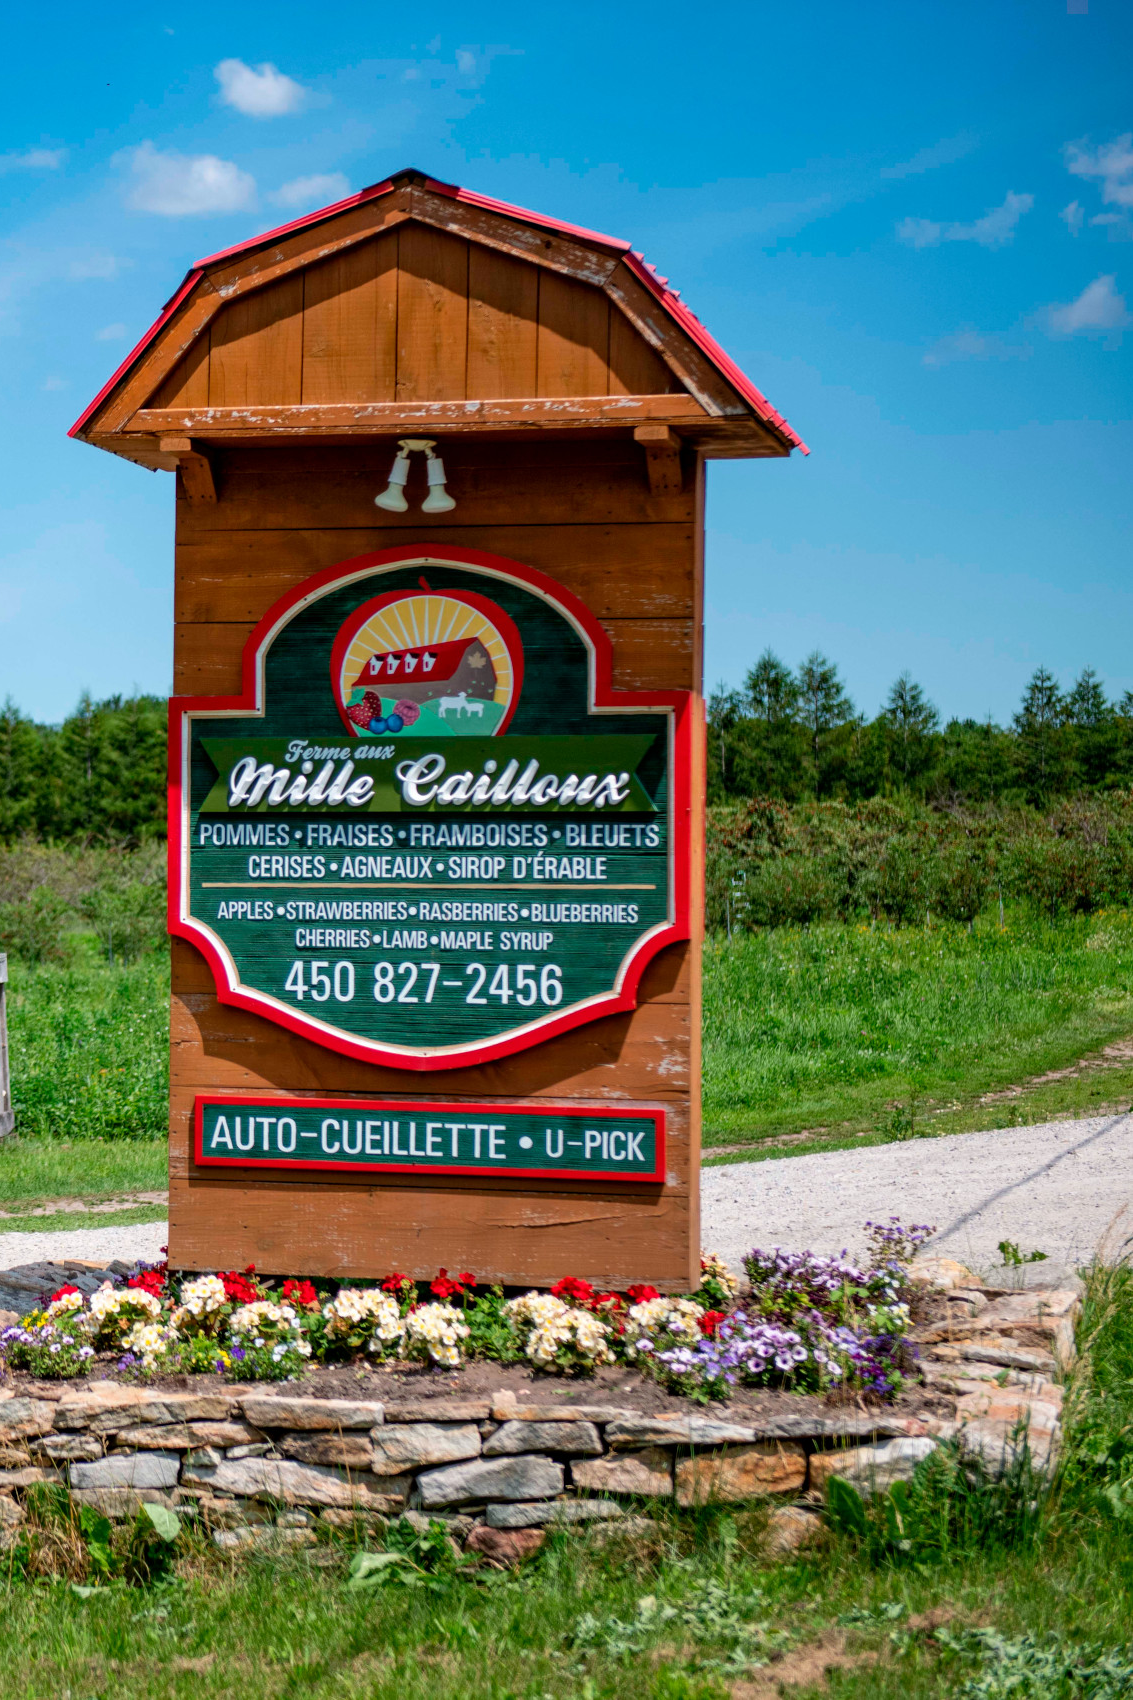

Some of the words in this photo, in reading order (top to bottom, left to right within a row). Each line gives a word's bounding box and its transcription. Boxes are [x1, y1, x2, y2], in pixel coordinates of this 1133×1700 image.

[285, 740, 351, 762] Ferme
[353, 744, 396, 760] aux
[229, 759, 376, 807] Mille
[397, 754, 630, 807] Cailloux
[201, 824, 289, 845] POMMES
[308, 825, 393, 846] FRAISES
[411, 825, 547, 846] FRAMBOISES
[567, 825, 659, 846] BLEUETS
[249, 856, 325, 877] CERISES
[341, 856, 432, 878] AGNEAUX
[449, 857, 505, 878] SIROP
[218, 901, 273, 919] APPLES
[286, 902, 407, 920] STRAWBERRIES
[420, 903, 518, 921] RASBERRIES
[532, 904, 638, 923] BLUEBERRIES
[296, 929, 370, 947] CHERRIES
[383, 931, 427, 948] LAMB
[441, 931, 493, 949] MAPLE
[500, 932, 553, 950] SYRUP
[285, 961, 355, 1002] 450
[374, 962, 562, 1006] 827-2456
[210, 1116, 507, 1160] AUTO-CUEILLETTE
[546, 1129, 645, 1161] U-PICK
